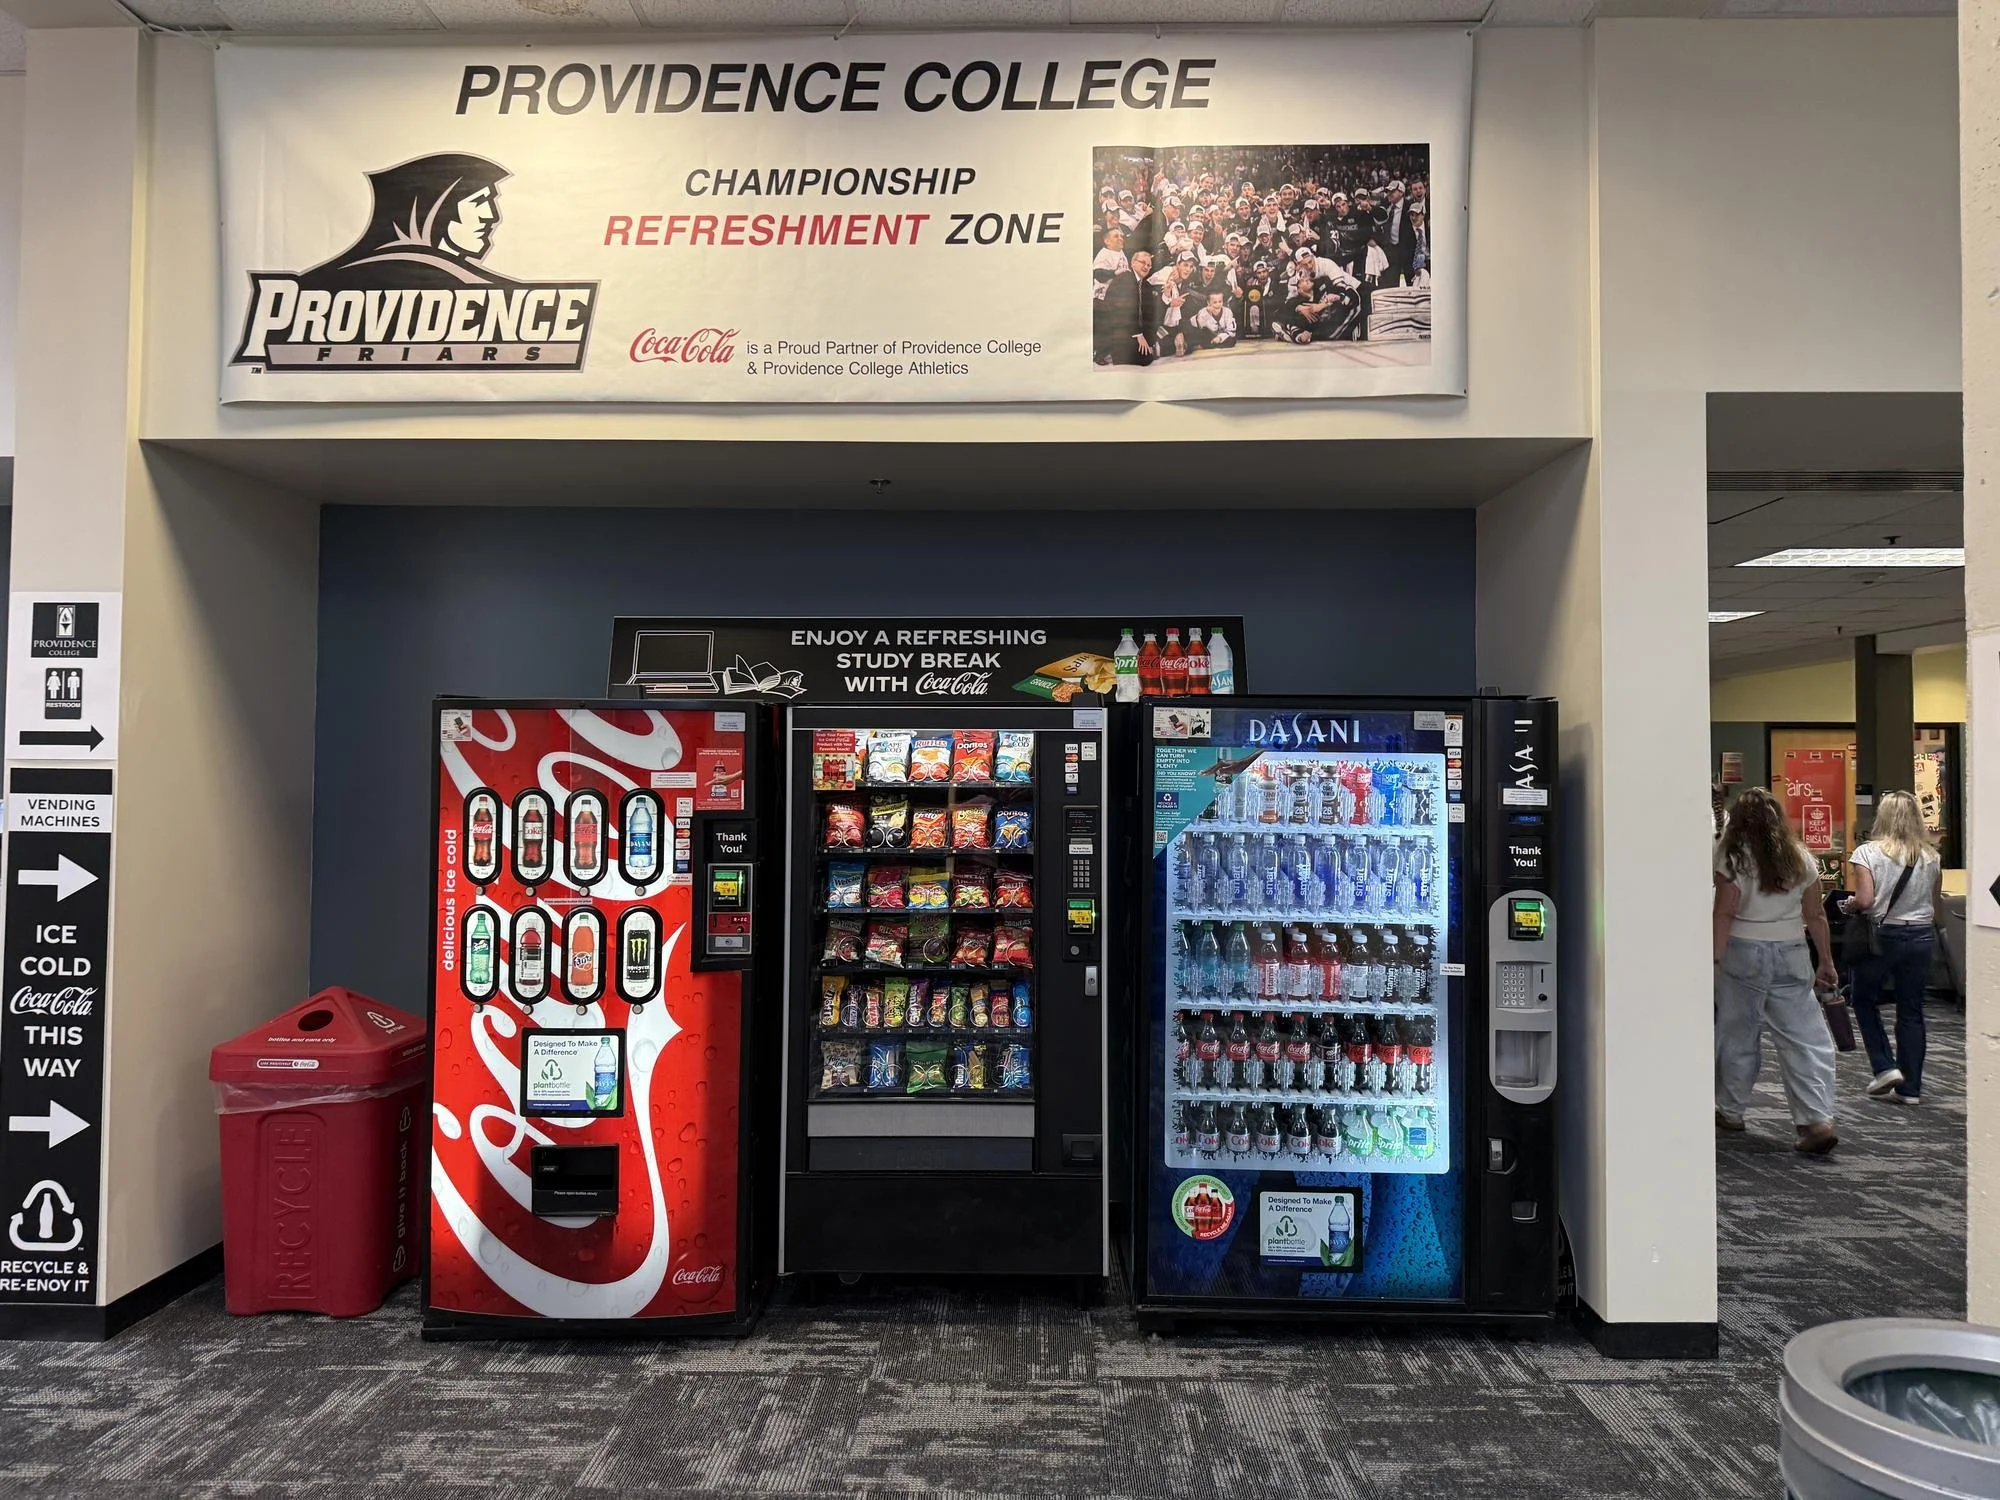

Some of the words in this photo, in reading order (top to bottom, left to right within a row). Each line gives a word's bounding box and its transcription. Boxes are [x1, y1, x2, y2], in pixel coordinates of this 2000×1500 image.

[455, 62, 886, 114] PROVIDENCE
[903, 58, 1216, 111] COLLEGE
[684, 167, 977, 197] CHAMPIONSHIP
[603, 213, 931, 246] REFRESHMENT
[945, 212, 1065, 244] ZONE
[240, 278, 592, 358] PROVIDENCE
[316, 345, 544, 362] FRIARS
[629, 327, 742, 364] Coca-Cola
[746, 340, 760, 355] is
[763, 343, 773, 355] a
[777, 340, 820, 355] Proud
[826, 340, 879, 355] Partner
[883, 340, 897, 355] of
[901, 339, 982, 355] Providence
[986, 339, 1042, 358] College
[747, 361, 758, 375] &
[763, 361, 844, 376] Providence
[848, 361, 904, 379] College
[908, 361, 969, 376] Athletics
[33, 639, 97, 649] PROVIDENCE
[791, 630, 869, 645] ENJOY
[873, 630, 890, 645] A
[897, 629, 1047, 645] REFRESHING
[836, 653, 915, 669] STUDY
[920, 652, 1001, 668] BREAK
[1189, 657, 1210, 668] oke
[844, 676, 908, 692] WITH
[915, 671, 993, 695] Coca-Cola
[1249, 712, 1360, 748] DASANI
[27, 799, 96, 811] VENDING
[21, 815, 100, 828] MACHINES
[716, 832, 747, 841] Thank
[445, 829, 457, 865] cold
[720, 845, 743, 854] You!
[1509, 845, 1541, 855] Thank
[1514, 859, 1537, 868] You!
[444, 869, 456, 893] ice
[36, 924, 77, 944] ICE
[442, 897, 456, 971] delicious
[20, 956, 92, 976] COLD
[9, 985, 99, 1016] Coca-Cola
[23, 1026, 83, 1046] THIS
[533, 1040, 566, 1049] Designed
[23, 1057, 82, 1078] WAY
[533, 1081, 571, 1090] plantbottle
[1319, 1139, 1337, 1149] oke
[273, 1127, 312, 1290] RECYCLE
[1268, 1196, 1301, 1205] Designed
[1200, 1229, 1221, 1237] RECYCLE
[1268, 1238, 1305, 1246] plantbottle
[0, 1260, 74, 1274] RECYCLE
[77, 1261, 89, 1275] &
[673, 1265, 721, 1285] Coca-Cola
[0, 1278, 71, 1292] RE-ENOY
[75, 1279, 89, 1292] IT
